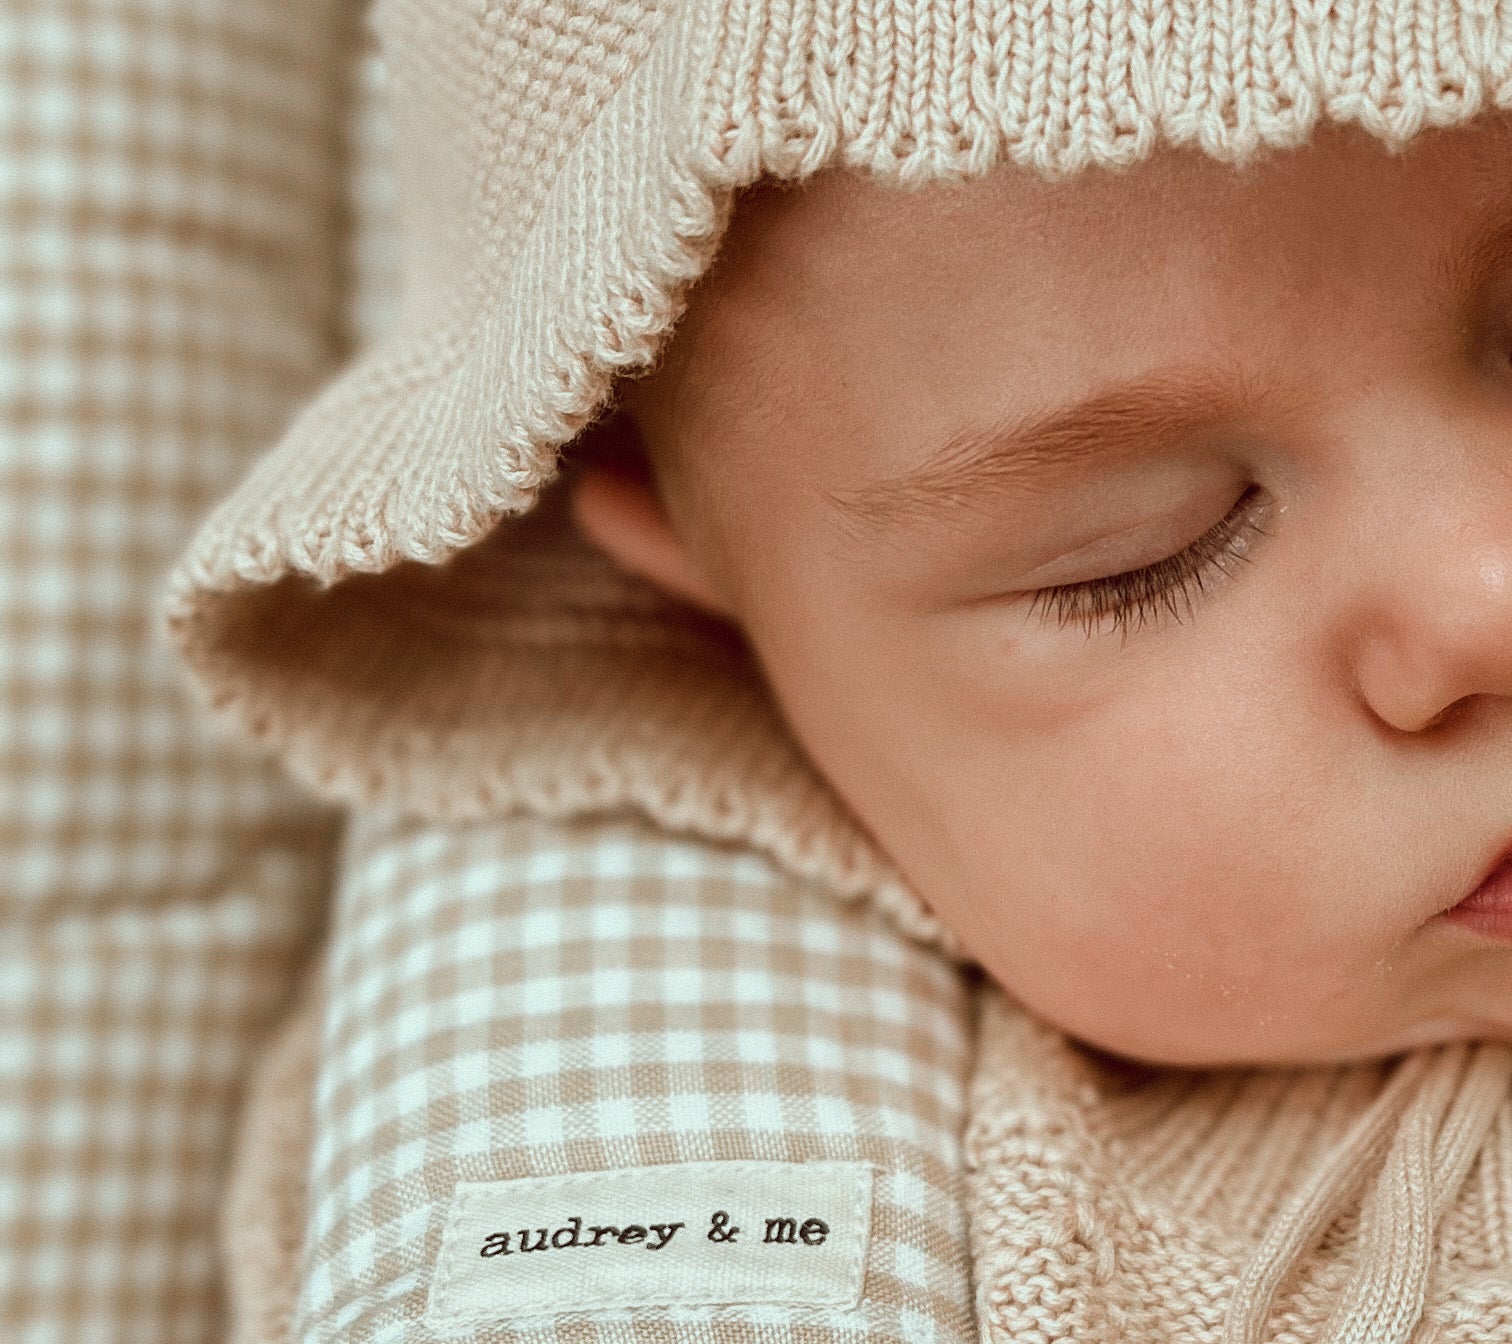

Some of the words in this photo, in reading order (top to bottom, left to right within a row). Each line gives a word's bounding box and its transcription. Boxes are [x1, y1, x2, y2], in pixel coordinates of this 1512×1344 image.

[480, 1217, 685, 1258] audrey
[707, 1211, 740, 1243] &
[762, 1215, 830, 1246] me
